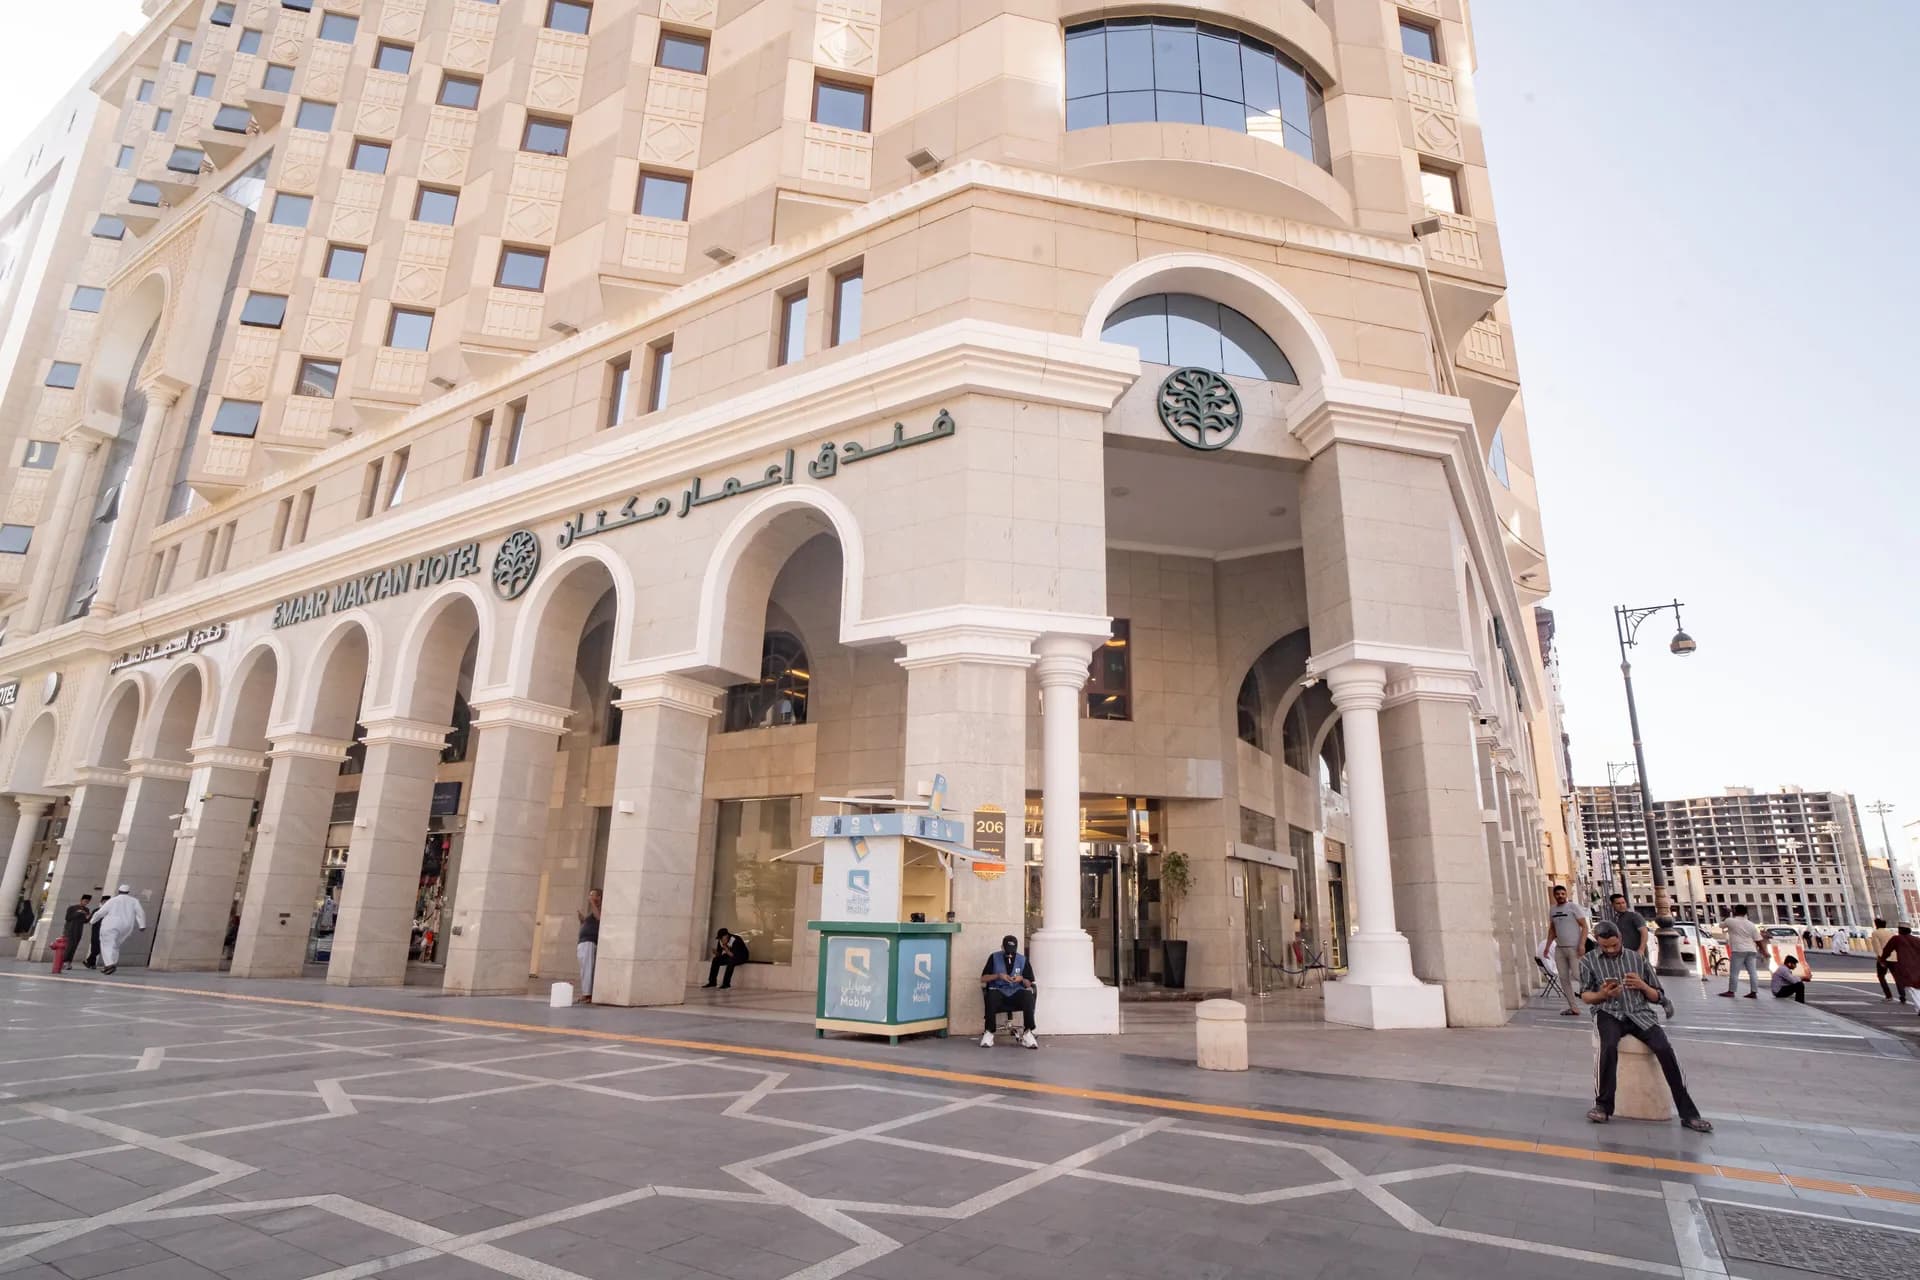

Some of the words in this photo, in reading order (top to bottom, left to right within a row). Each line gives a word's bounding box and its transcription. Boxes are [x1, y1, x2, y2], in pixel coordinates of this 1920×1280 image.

[807, 408, 955, 480] فندق
[556, 495, 671, 550] مكتان
[272, 591, 330, 630] EMAAR
[332, 563, 411, 613] MAKTAN
[414, 543, 481, 590] HOTEL
[976, 820, 1004, 833] 206
[840, 994, 871, 1010] Mobily
